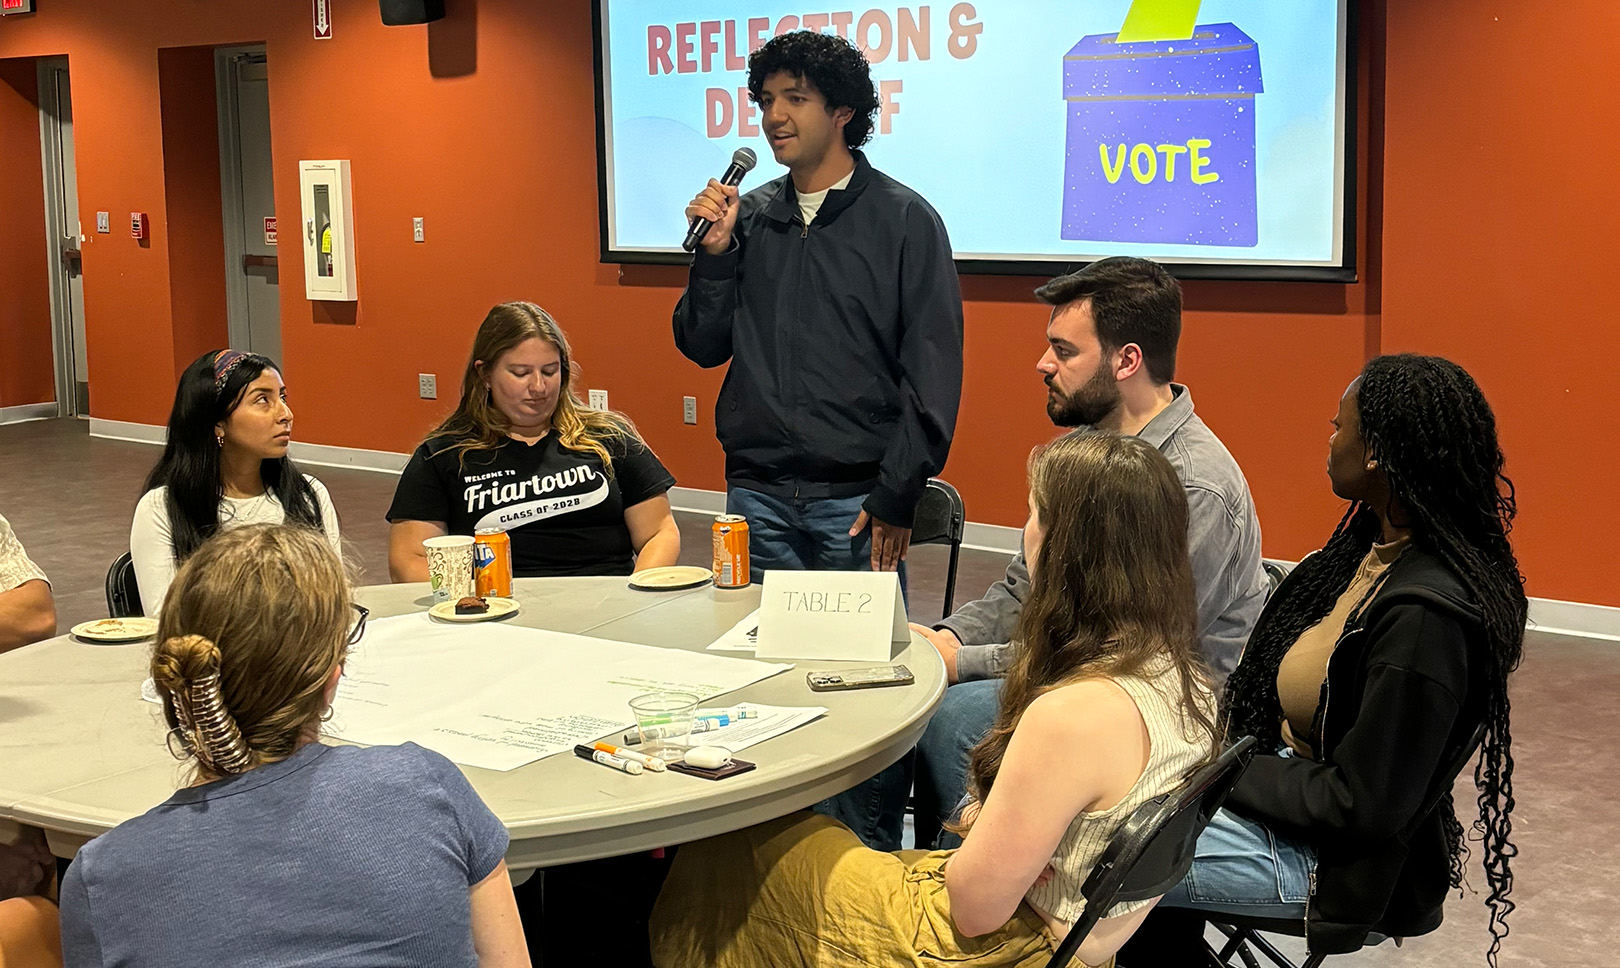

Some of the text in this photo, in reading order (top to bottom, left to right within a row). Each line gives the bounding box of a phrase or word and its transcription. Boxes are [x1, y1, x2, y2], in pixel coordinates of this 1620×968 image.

[947, 2, 983, 60] &
[1099, 139, 1219, 185] VOTE
[463, 464, 596, 513] Friartown
[464, 470, 503, 483] WELCOME
[499, 497, 581, 524] CLASS OF 2028
[783, 591, 873, 613] TABLE 2
